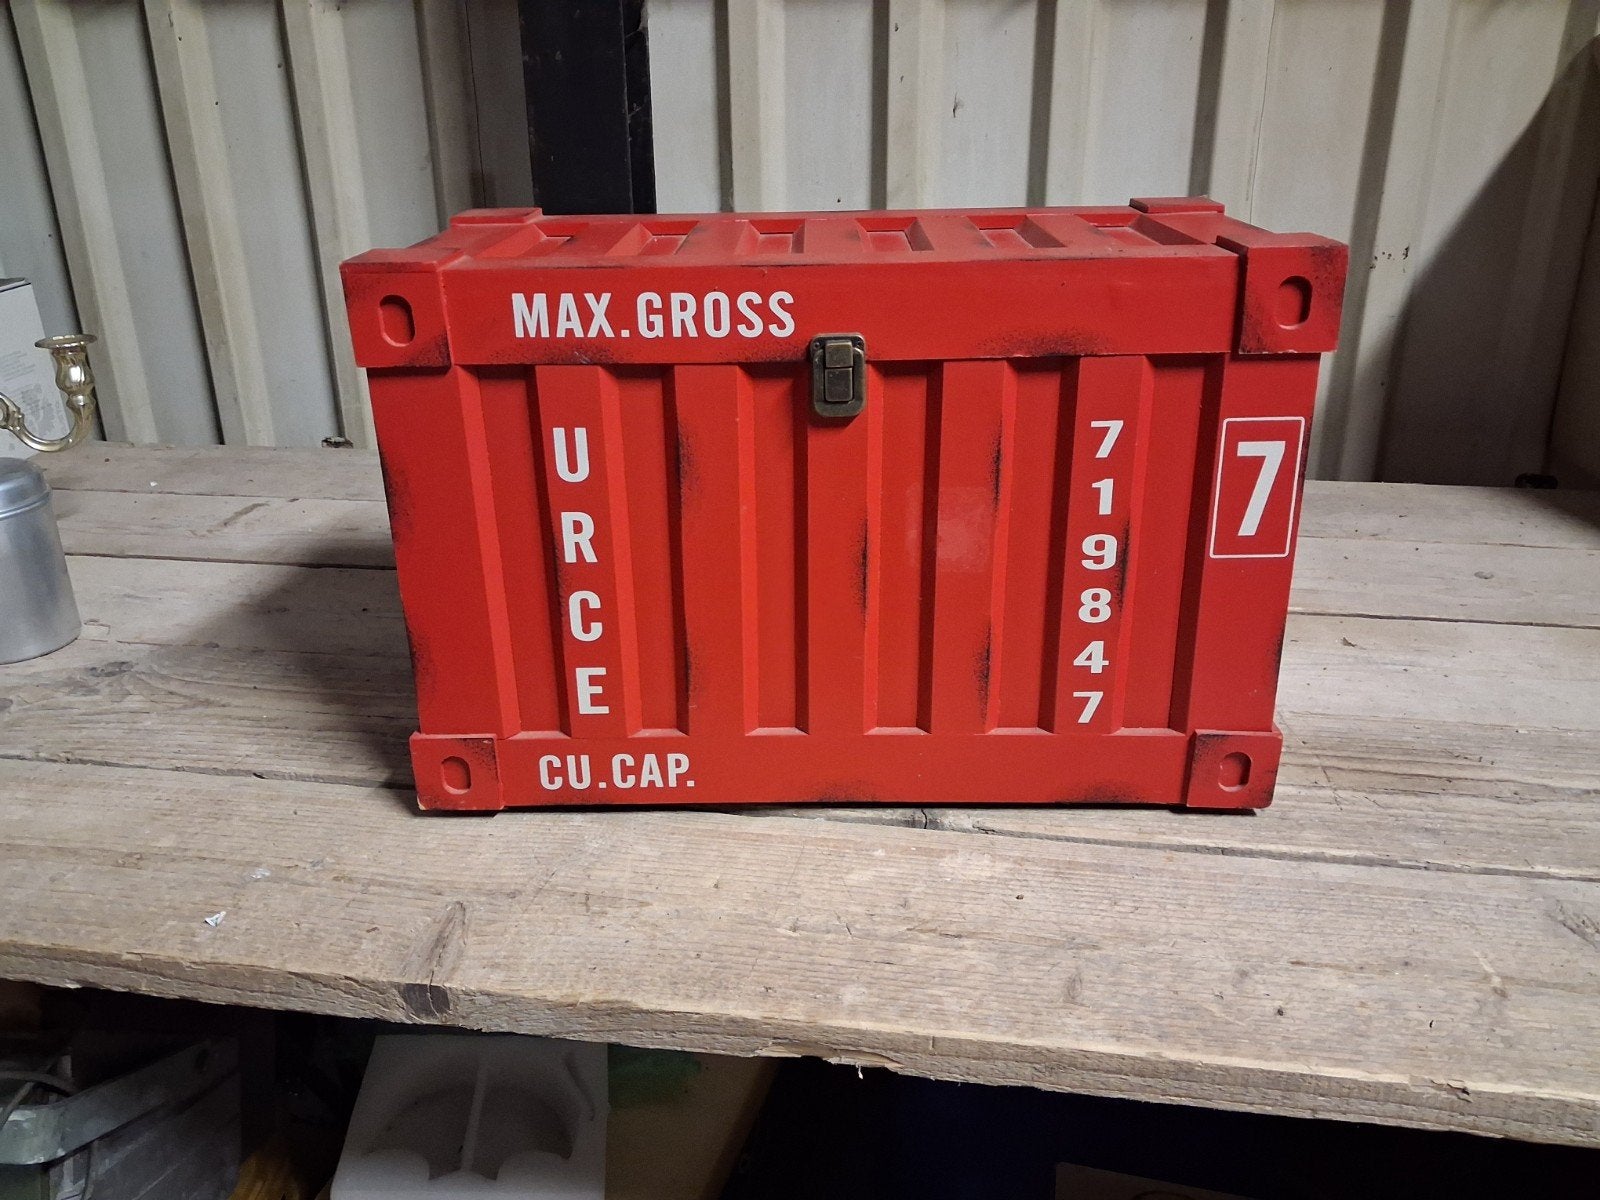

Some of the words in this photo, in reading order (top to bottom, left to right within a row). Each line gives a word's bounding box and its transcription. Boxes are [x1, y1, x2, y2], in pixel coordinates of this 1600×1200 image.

[511, 291, 796, 339] MAX.GROSS
[1236, 440, 1286, 537] 7
[538, 753, 695, 791] CU.CAP.
